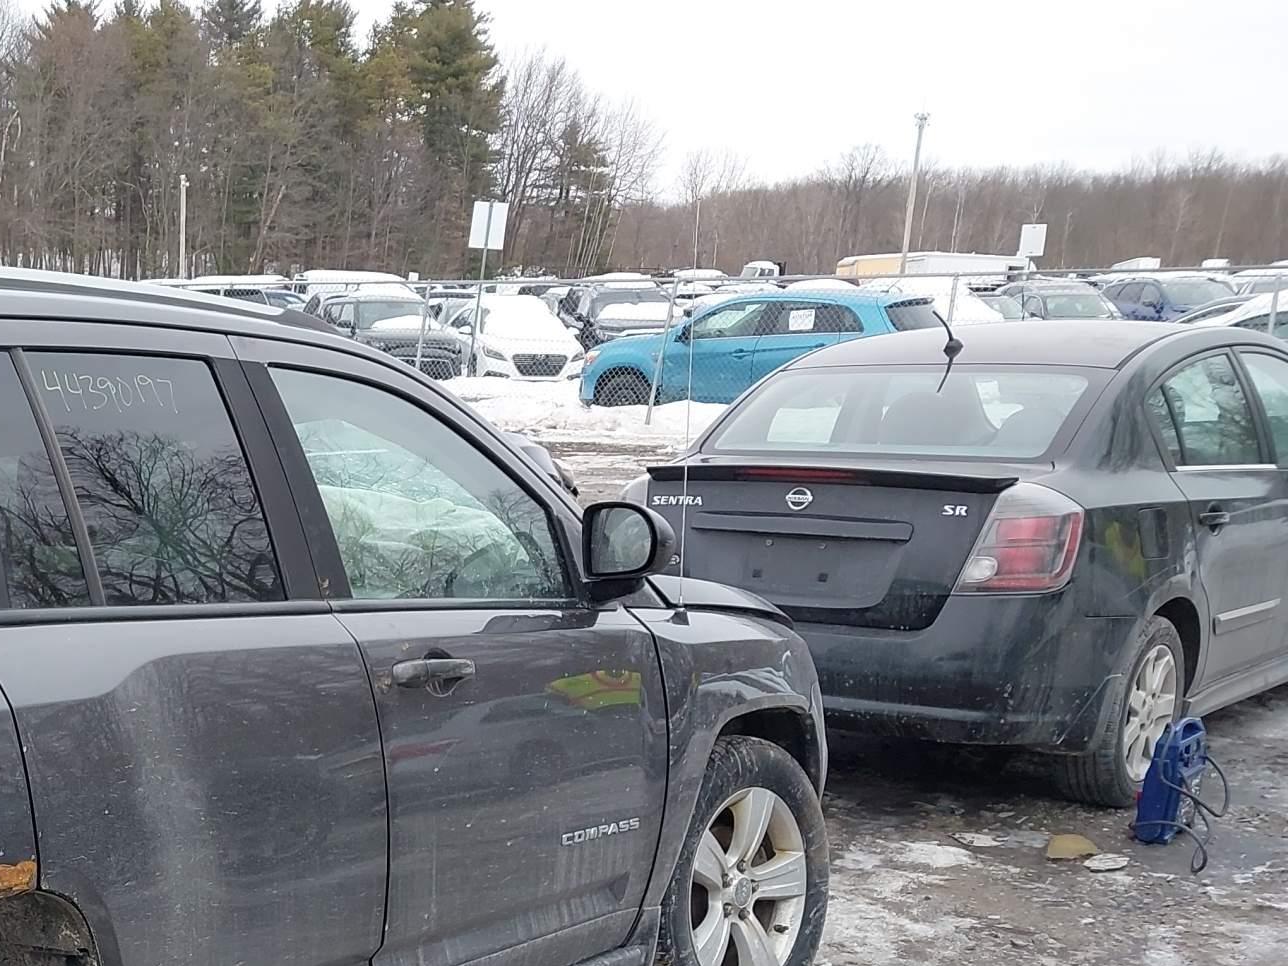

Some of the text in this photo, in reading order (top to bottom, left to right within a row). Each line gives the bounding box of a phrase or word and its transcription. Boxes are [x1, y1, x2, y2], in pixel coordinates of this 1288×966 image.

[41, 370, 179, 414] 44390197
[652, 495, 703, 506] SENTRA
[942, 504, 968, 516] SR
[561, 817, 640, 846] COMPASS
